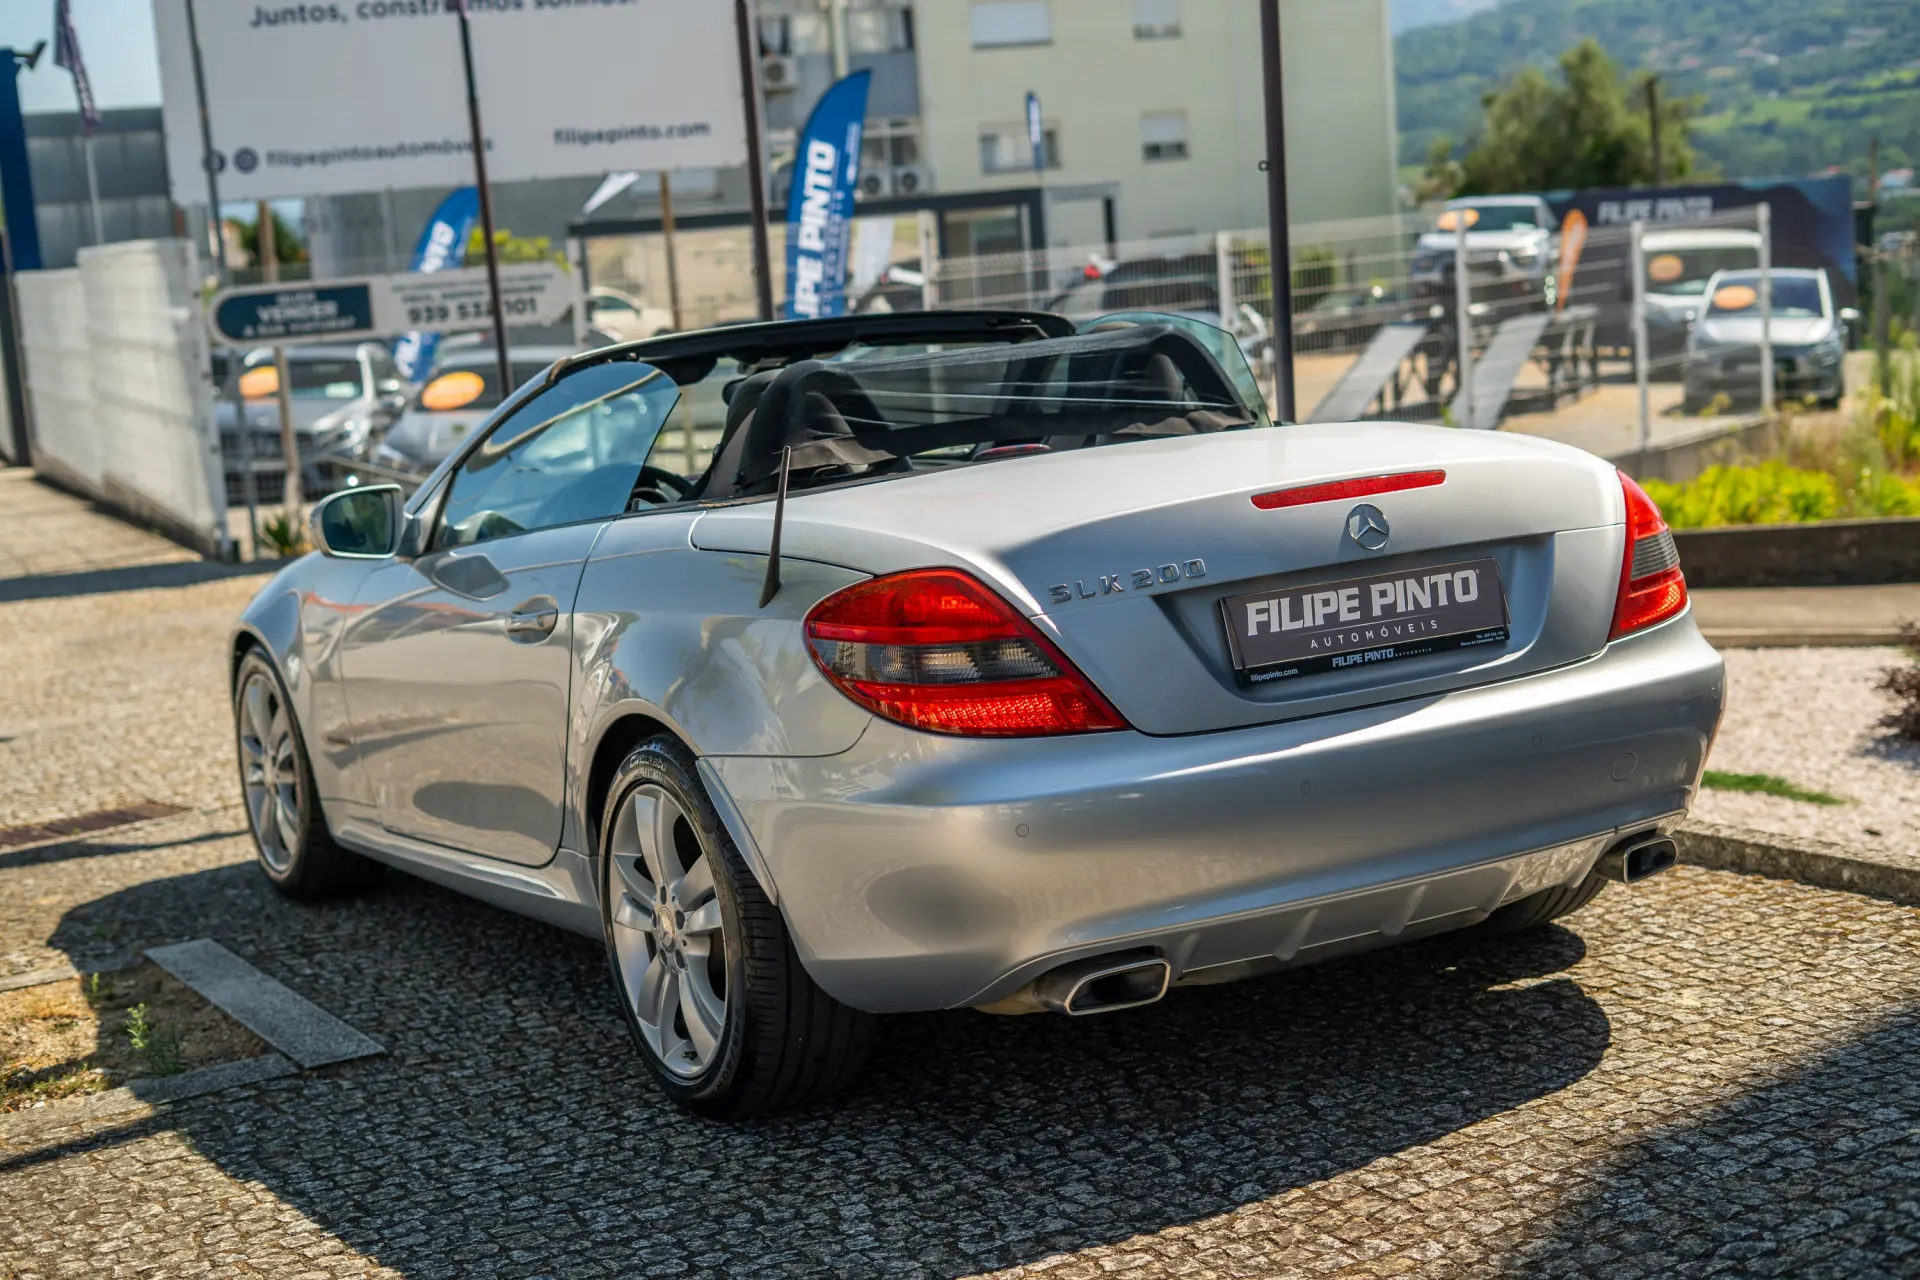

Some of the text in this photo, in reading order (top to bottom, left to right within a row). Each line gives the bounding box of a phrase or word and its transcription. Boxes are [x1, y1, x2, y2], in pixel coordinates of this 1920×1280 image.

[248, 4, 348, 28] Juntos,
[552, 121, 711, 146] filipepinto.com
[798, 137, 836, 251] PINTO
[256, 300, 338, 322] VENDER
[1049, 558, 1207, 604] SLK 200
[1246, 569, 1479, 637] FILIPE PINTO
[1309, 618, 1439, 649] AUTOMÓVEIS
[1250, 668, 1298, 682] filipepinto.com
[1332, 653, 1363, 668] FILIPE
[1364, 648, 1394, 663] PINTO
